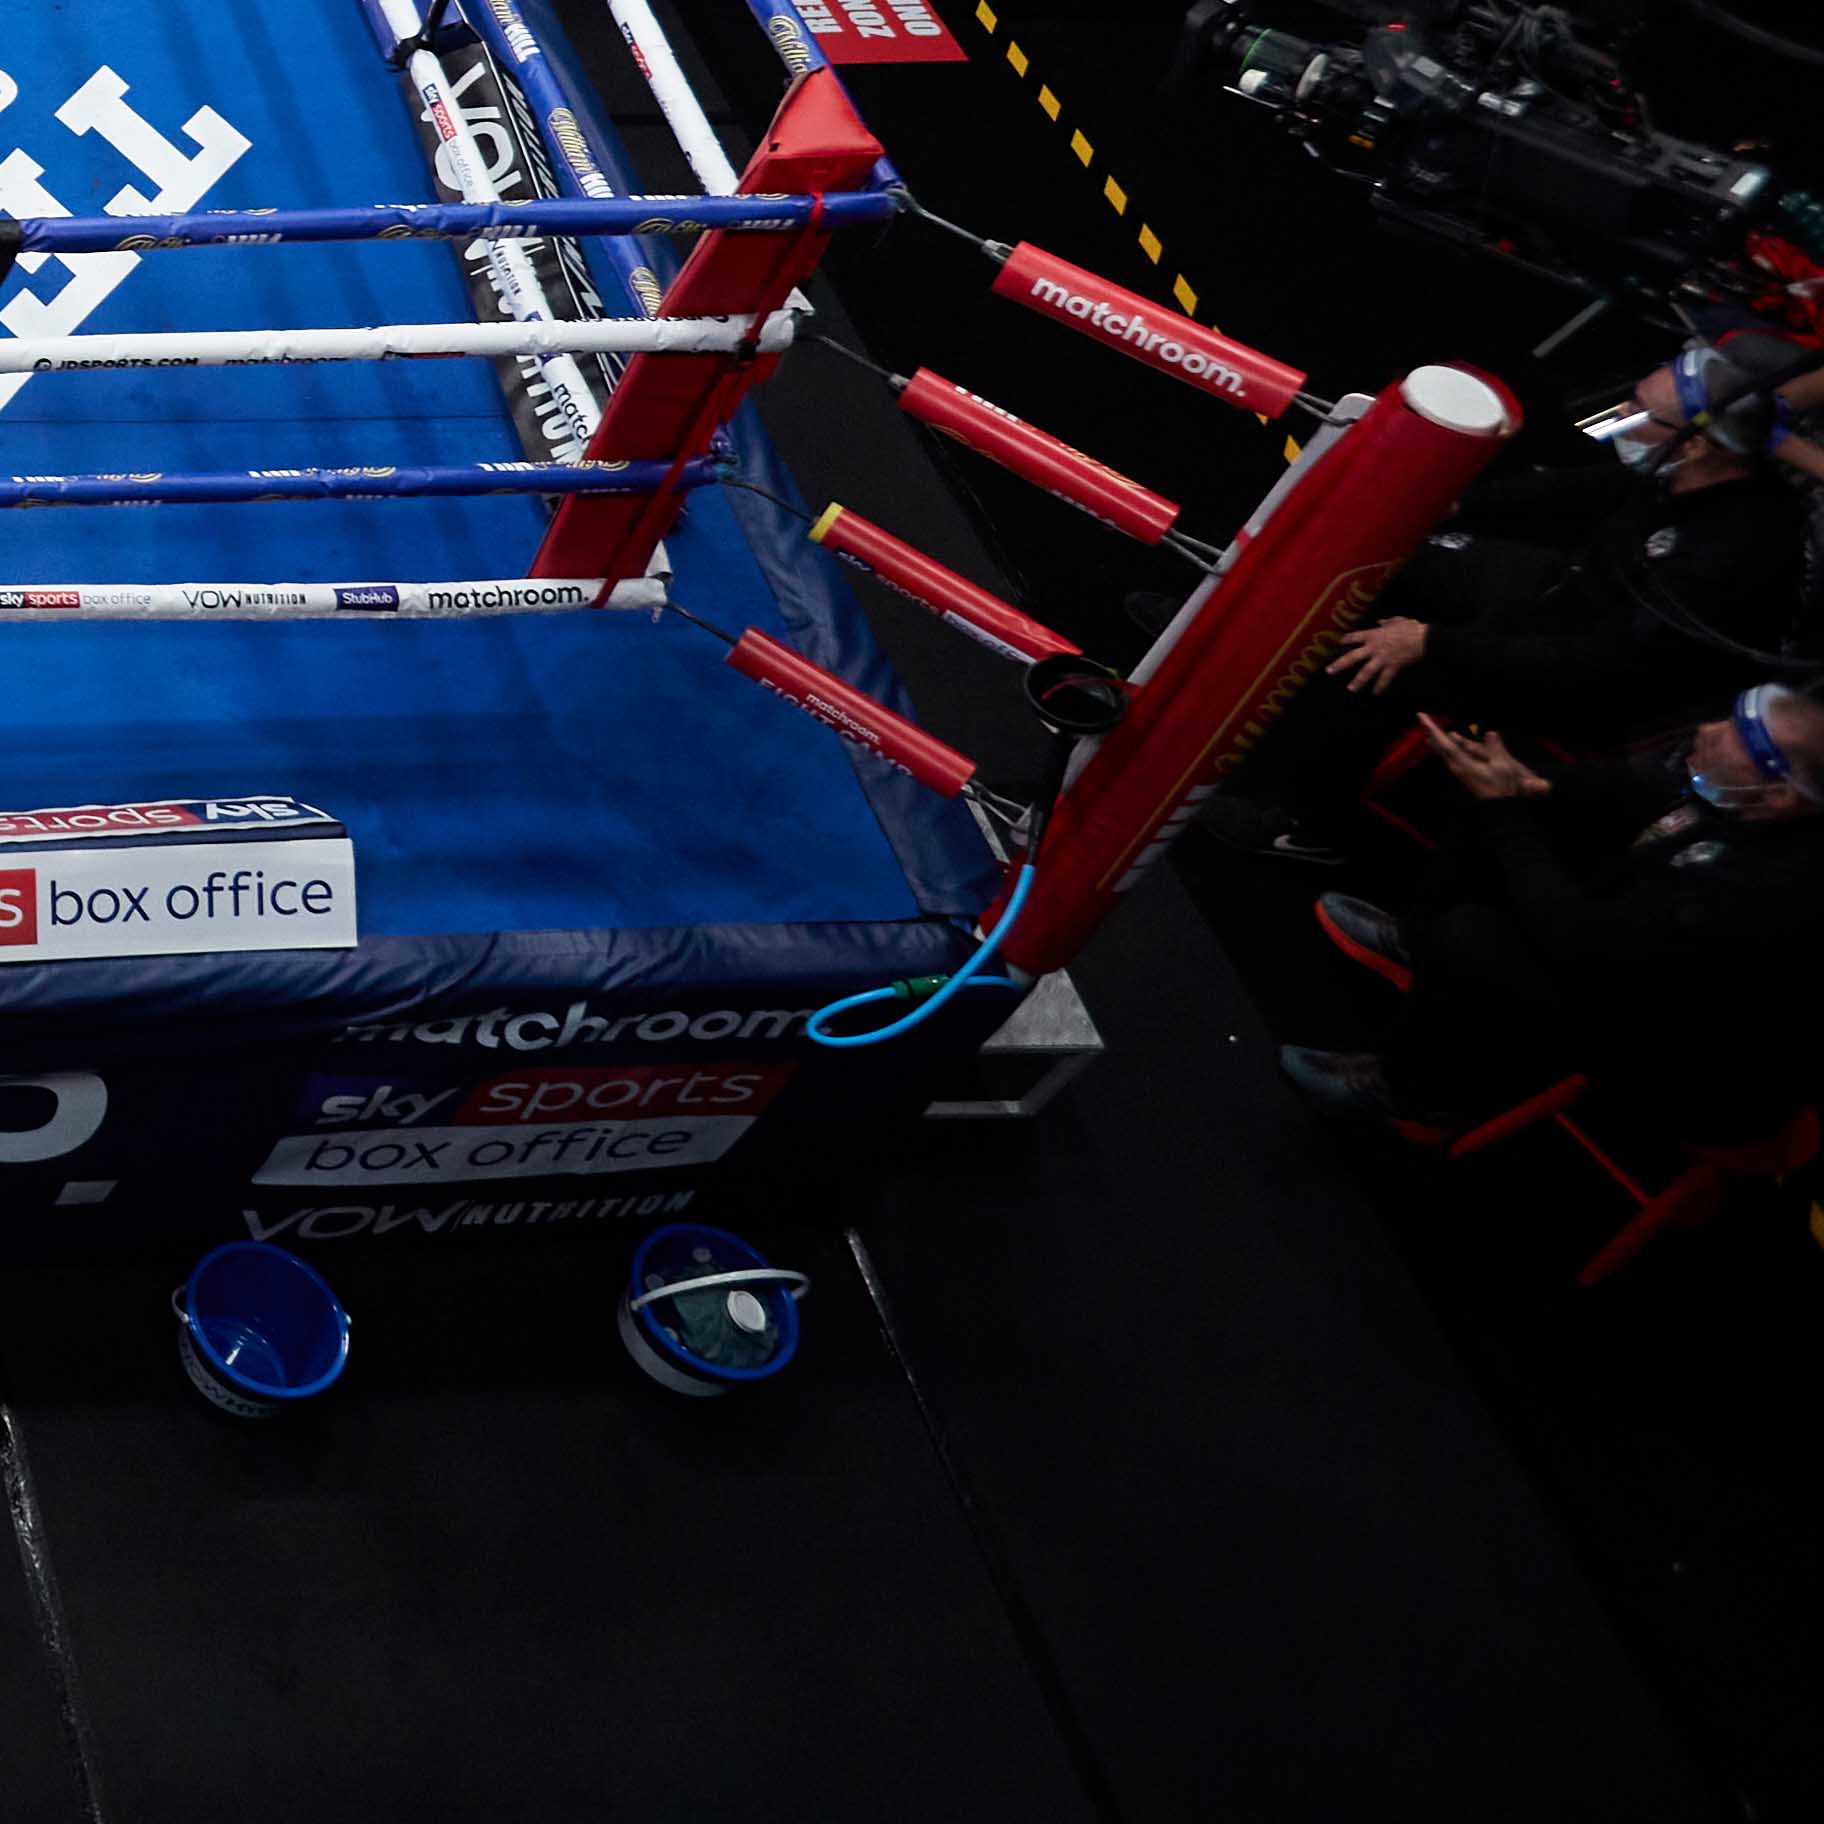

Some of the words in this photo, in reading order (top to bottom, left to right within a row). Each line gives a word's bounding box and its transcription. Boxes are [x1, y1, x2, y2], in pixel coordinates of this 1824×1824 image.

[1031, 277, 1249, 400] matchroom.
[49, 878, 151, 928] box
[164, 869, 335, 921] office
[317, 1084, 458, 1126] sky
[478, 1069, 765, 1114] sports
[303, 1134, 454, 1172] box
[465, 1125, 693, 1166] office
[242, 1201, 464, 1242] VOW
[459, 1190, 696, 1229] NUTRITION
